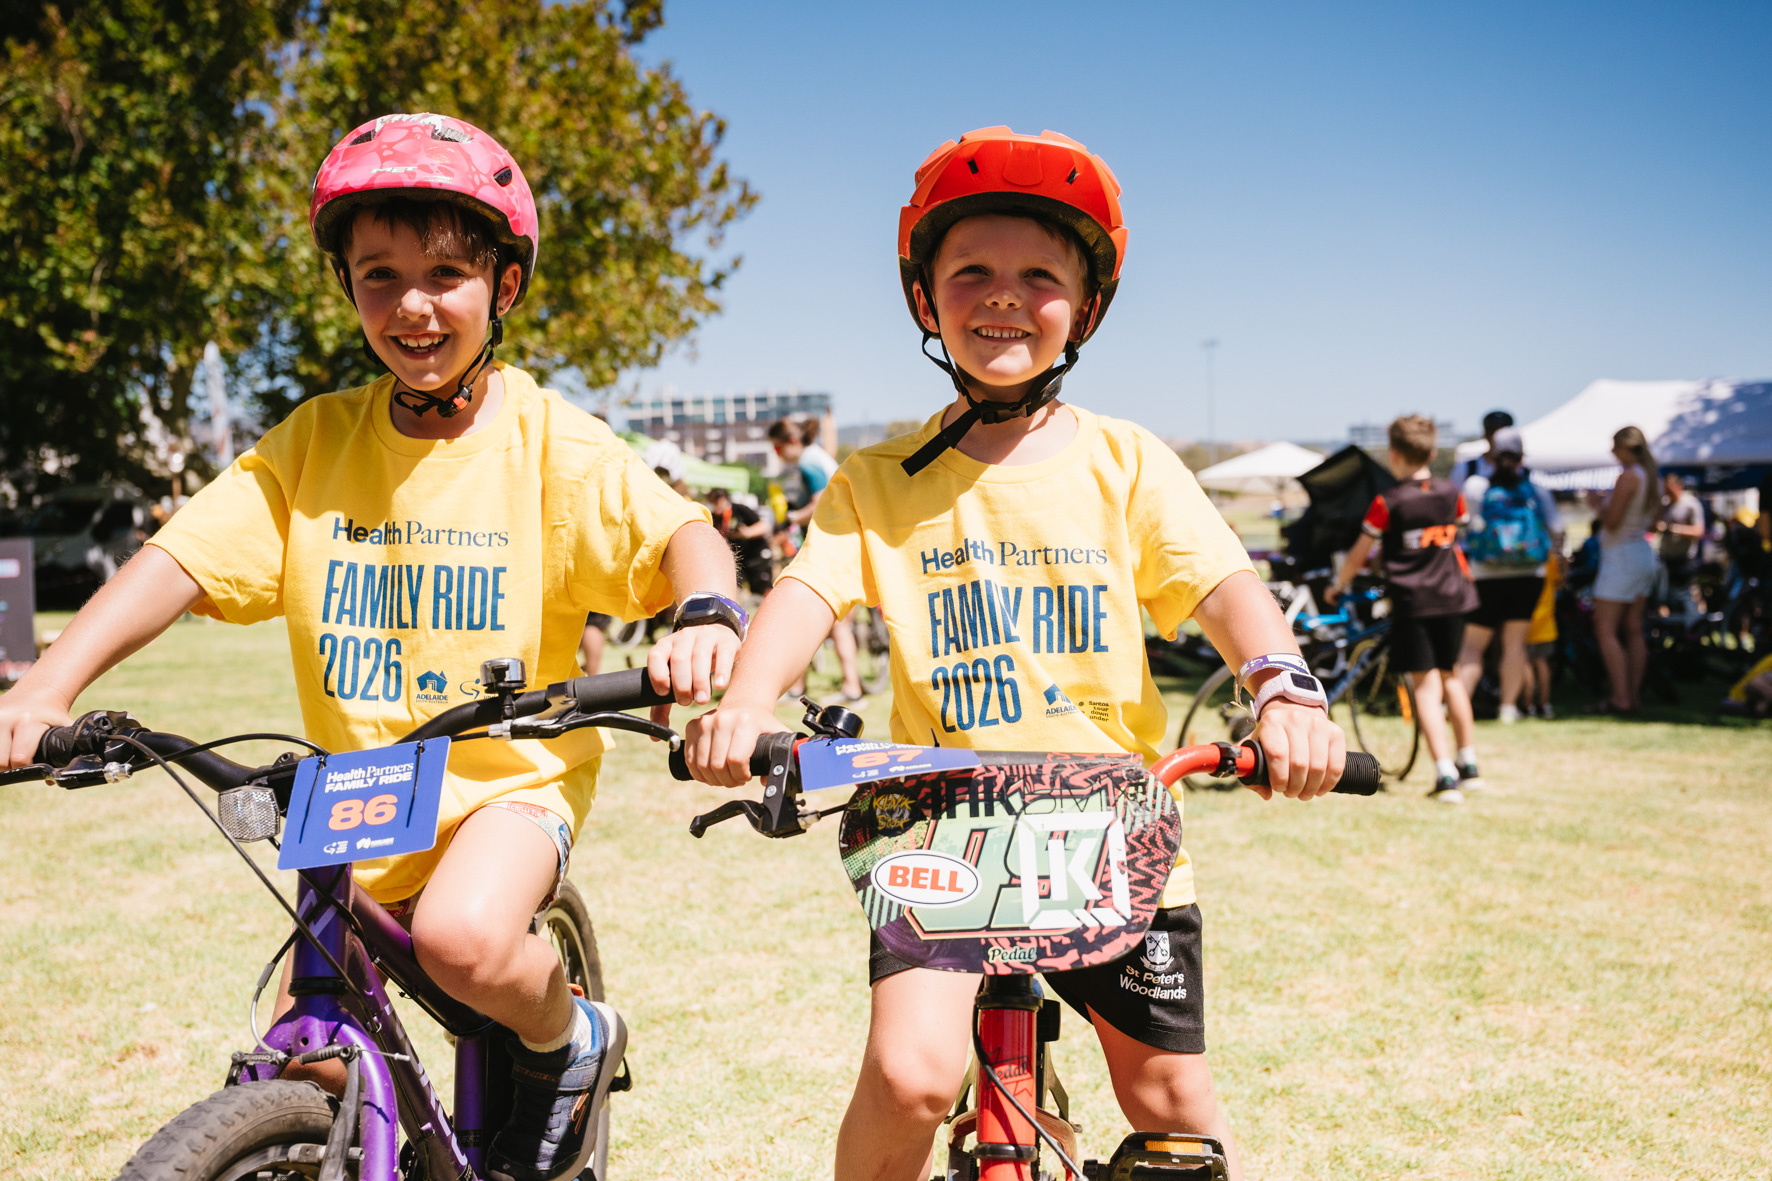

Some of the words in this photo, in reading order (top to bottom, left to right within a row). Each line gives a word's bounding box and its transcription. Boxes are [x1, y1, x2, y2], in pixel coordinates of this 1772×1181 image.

[371, 166, 418, 175] MET
[333, 517, 401, 546] Health
[405, 520, 509, 548] Partners
[920, 538, 994, 574] Health
[998, 541, 1108, 567] Partners
[321, 559, 424, 630] FAMILY
[432, 565, 507, 631] RIDE
[927, 579, 1023, 658] FAMILY
[1032, 584, 1109, 654] RIDE
[319, 633, 402, 702] 2026
[416, 693, 448, 701] ADELAIDE
[931, 654, 1022, 733] 2026
[852, 749, 923, 768] 87
[324, 777, 377, 793] FAMILY
[378, 771, 413, 785] RIDE
[327, 768, 366, 783] Health
[366, 763, 414, 778] Partners
[328, 794, 398, 831] 86
[888, 865, 964, 893] BELL
[987, 945, 1037, 963] Pedal
[1120, 974, 1187, 1000] Woodlands
[1126, 965, 1141, 978] St
[1143, 972, 1185, 985] Peter's
